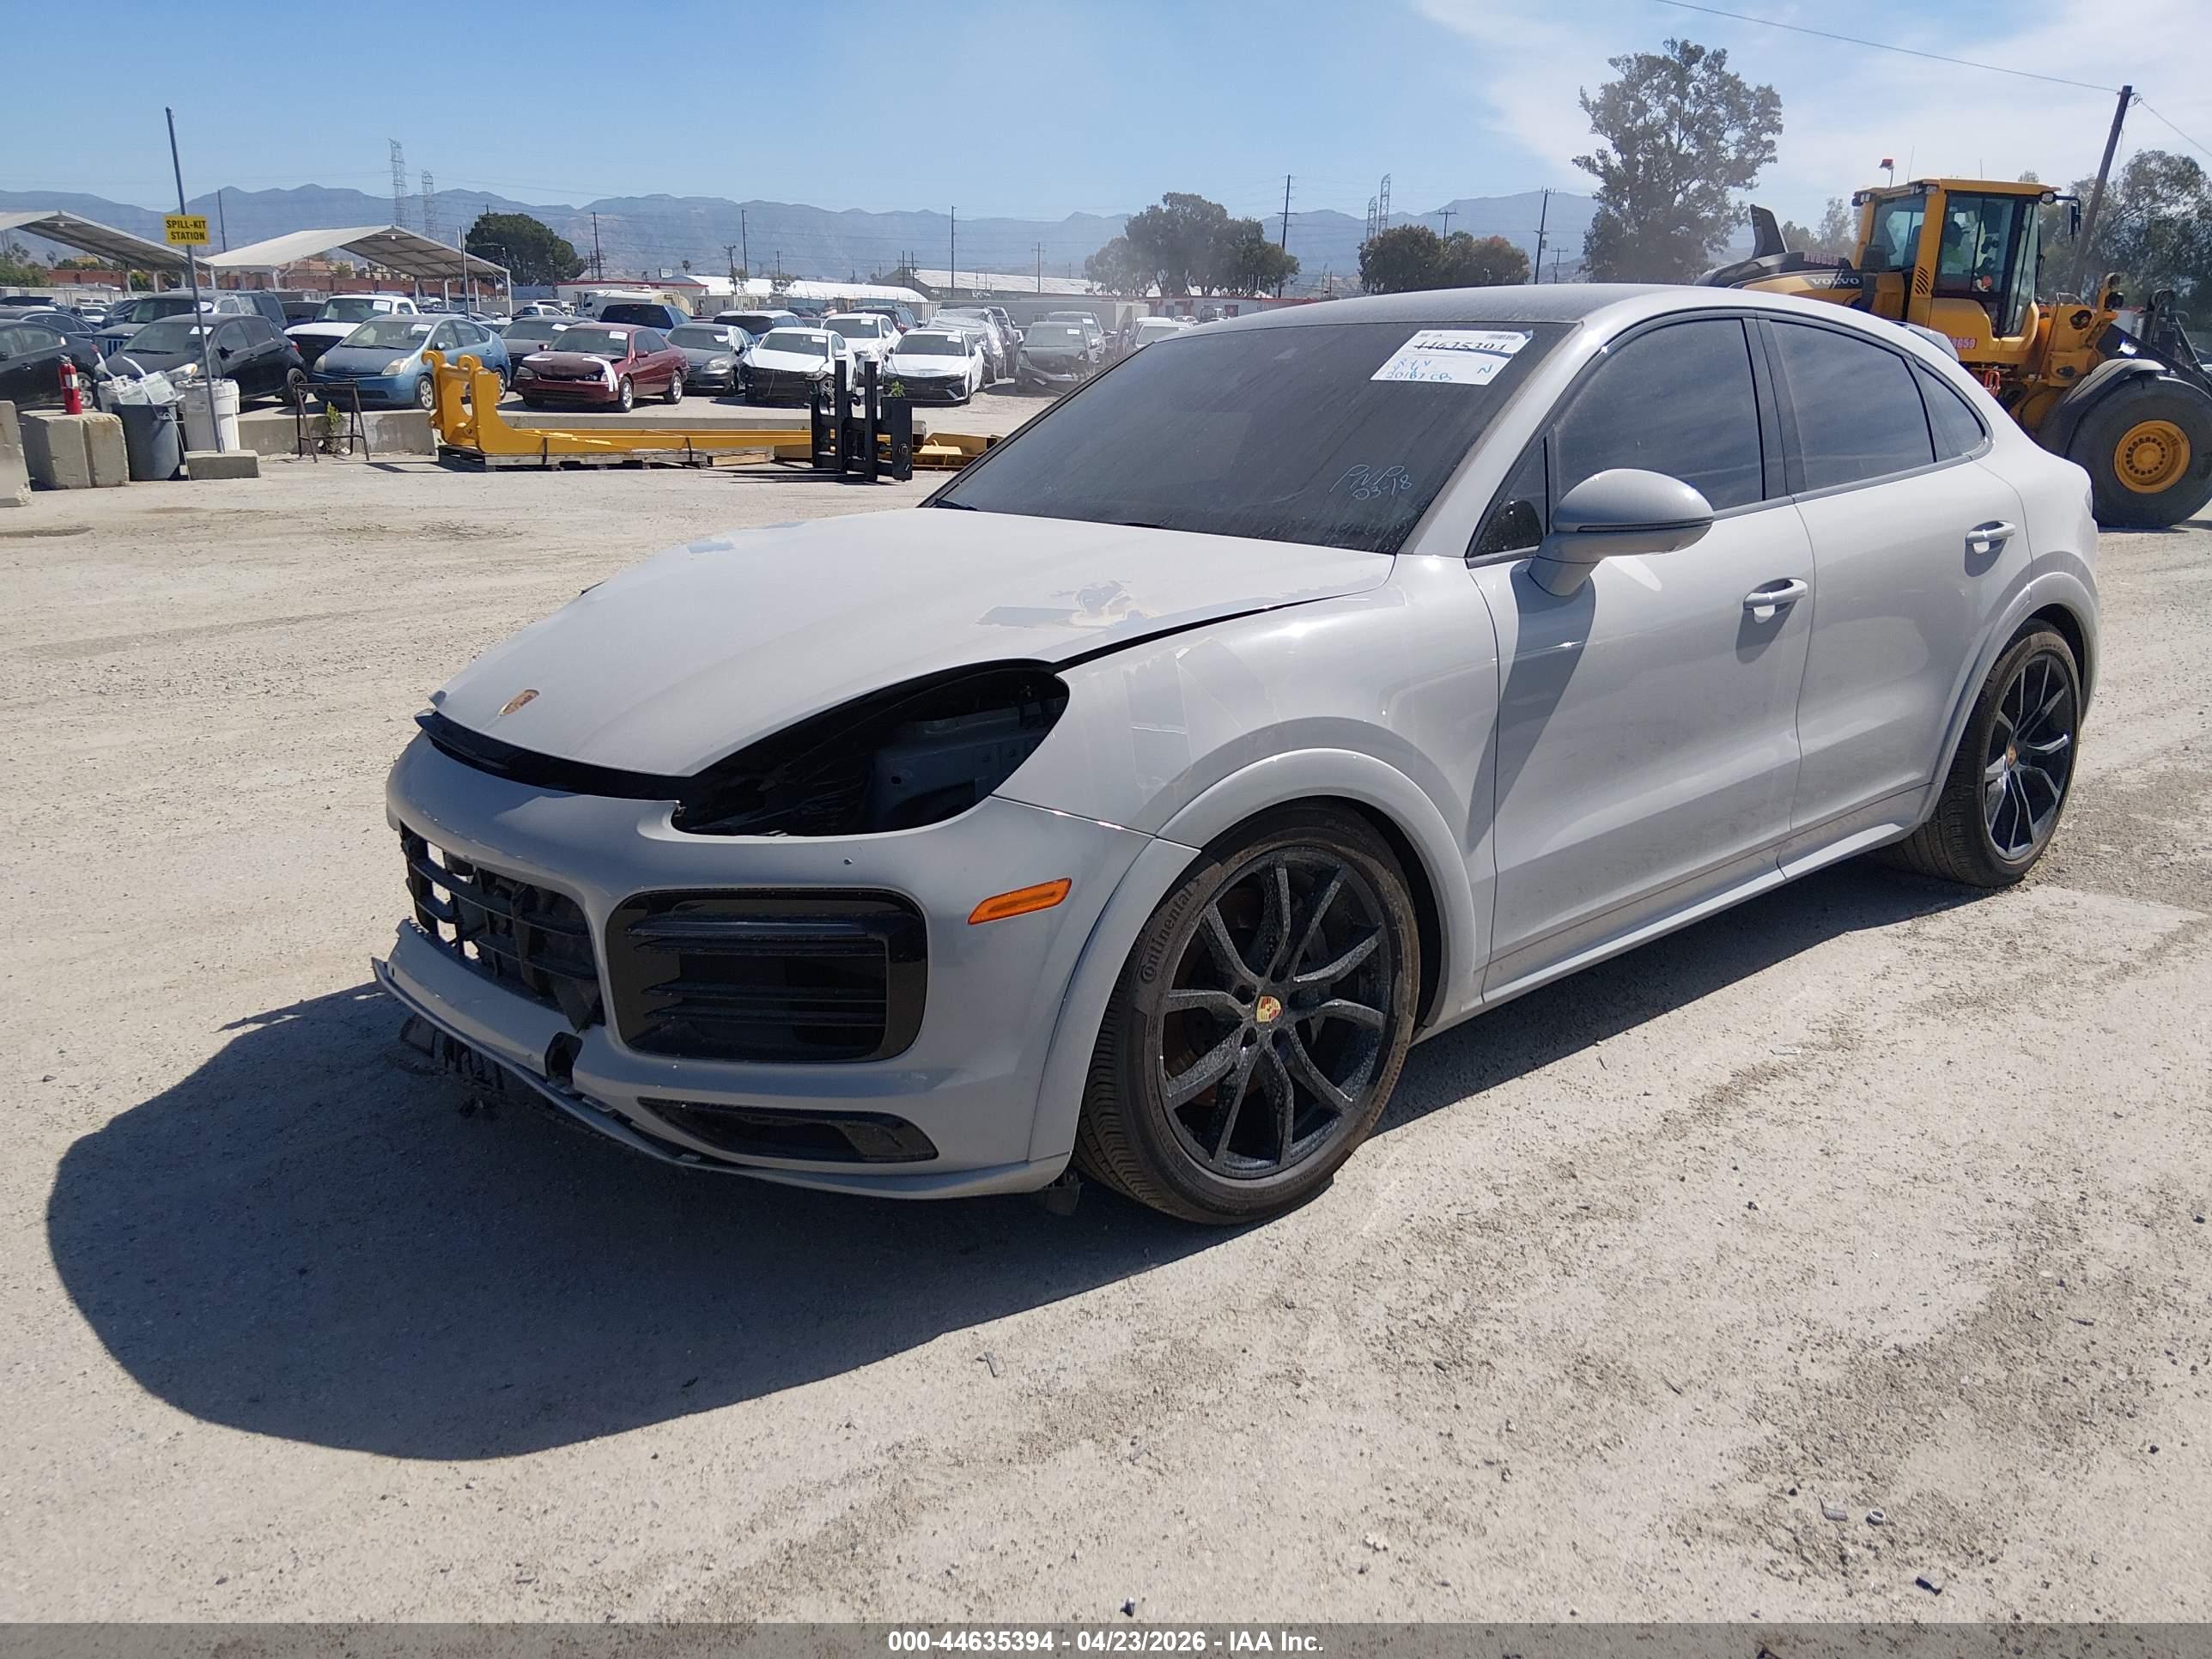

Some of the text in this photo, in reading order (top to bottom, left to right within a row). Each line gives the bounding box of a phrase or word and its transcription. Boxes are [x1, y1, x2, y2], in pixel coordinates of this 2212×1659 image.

[166, 219, 207, 228] SPILL-KIT
[171, 231, 206, 240] STATION
[1352, 474, 1413, 501] 03-18
[1141, 887, 1193, 983] Continental
